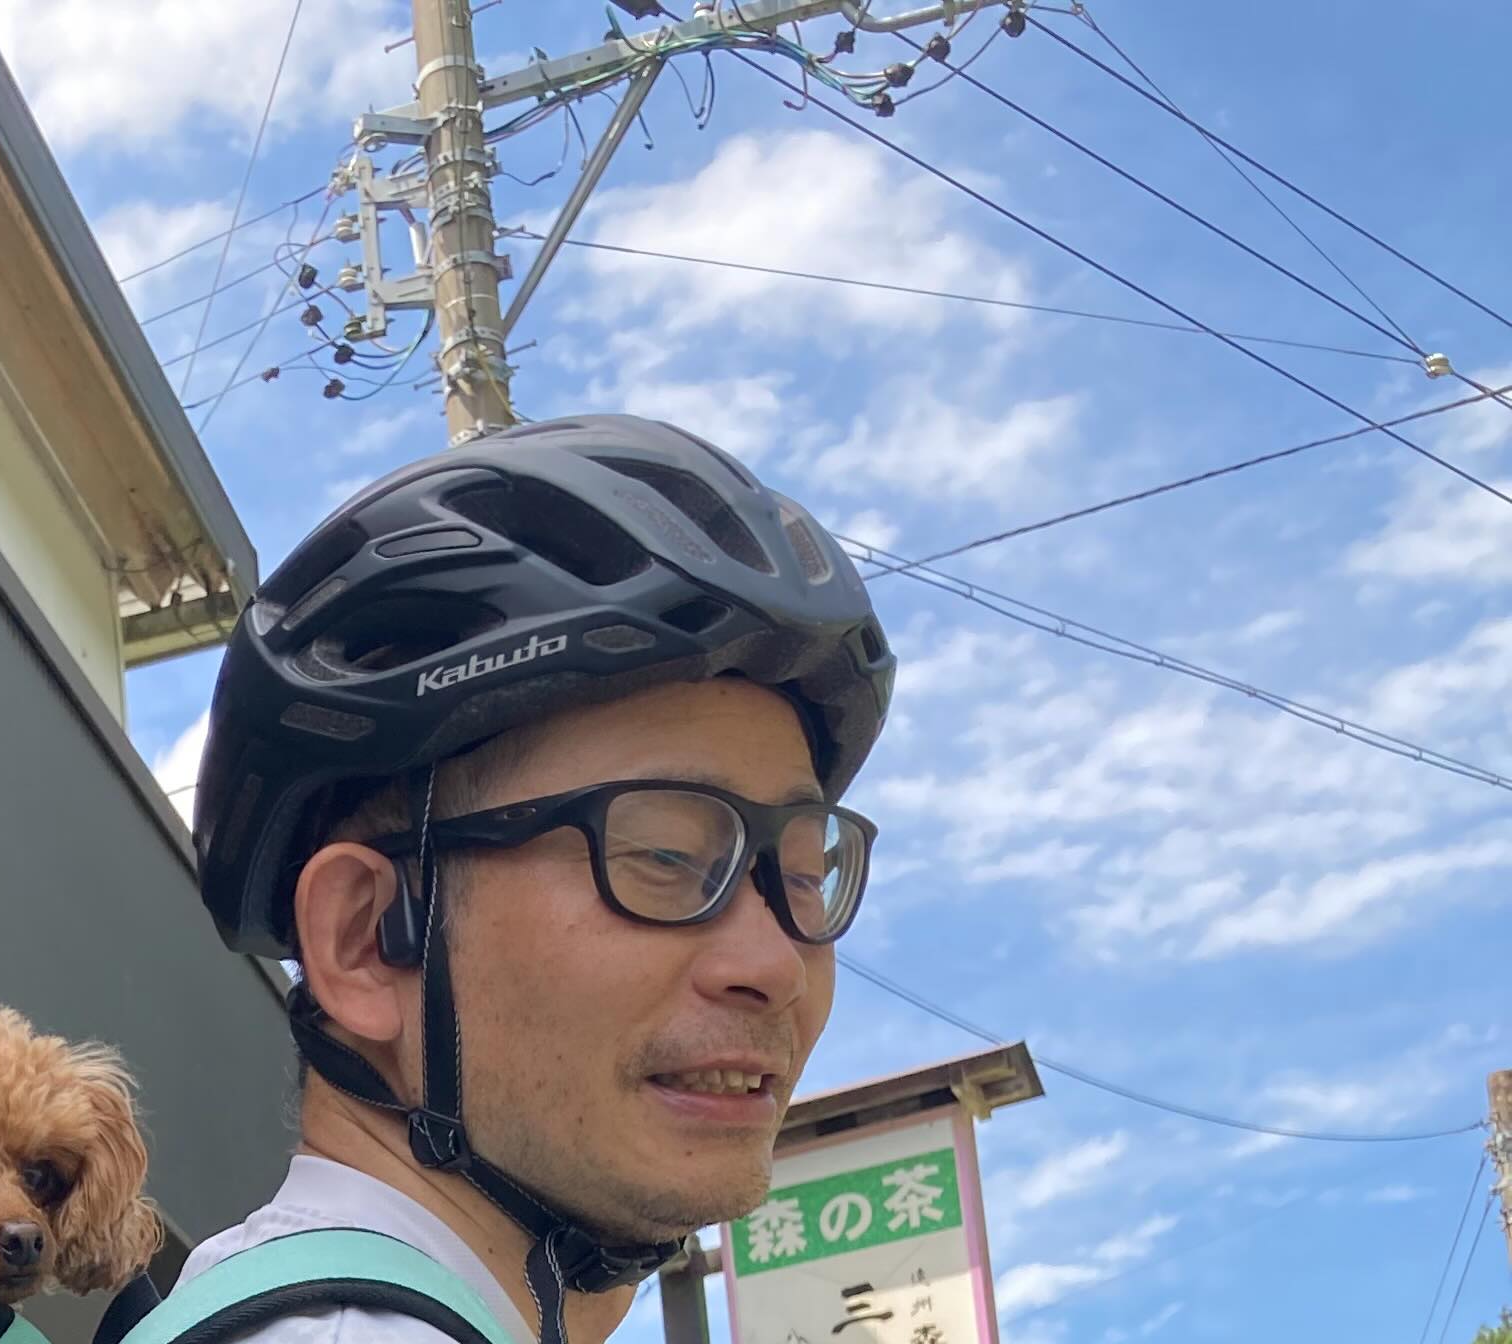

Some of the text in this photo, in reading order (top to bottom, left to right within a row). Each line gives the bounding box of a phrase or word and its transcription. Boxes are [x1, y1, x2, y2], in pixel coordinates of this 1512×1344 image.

[416, 634, 570, 697] Kabuto
[746, 1163, 946, 1265] 森の茶
